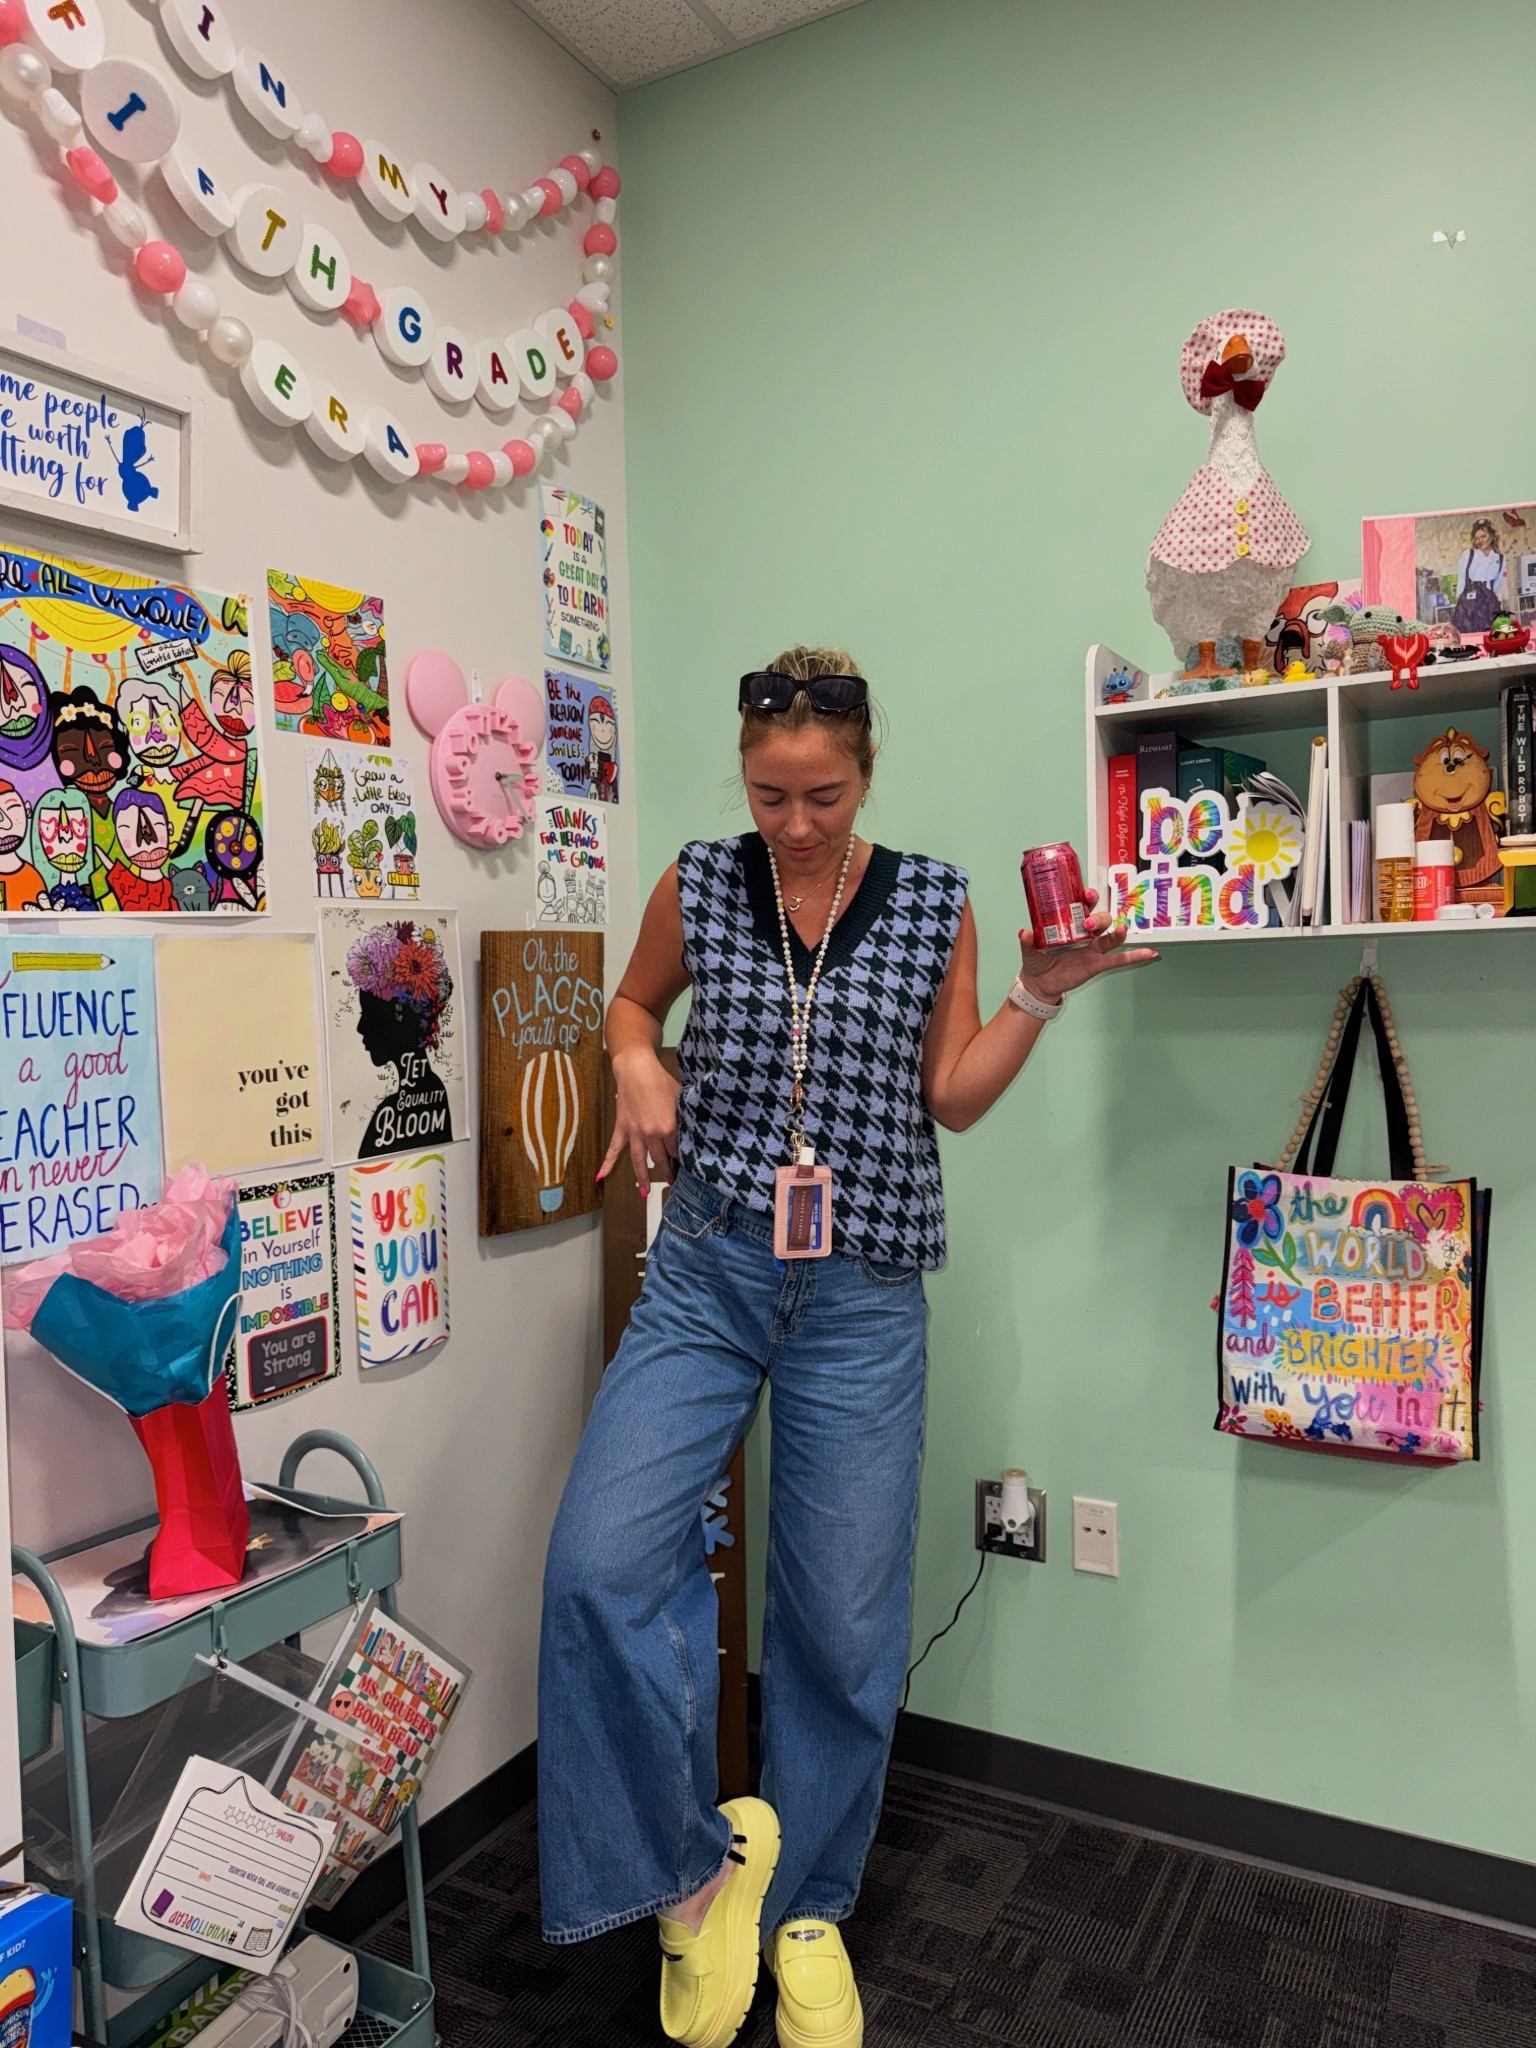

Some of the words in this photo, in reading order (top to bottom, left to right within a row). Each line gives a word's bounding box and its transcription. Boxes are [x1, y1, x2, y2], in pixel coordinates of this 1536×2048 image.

[378, 153, 450, 217] MY
[398, 305, 576, 385] GRADE
[45, 391, 120, 438] people
[273, 363, 409, 460] ERA
[28, 423, 91, 459] worth
[76, 461, 108, 504] for
[563, 523, 594, 555] TODAY
[559, 560, 585, 586] GREAT
[586, 571, 600, 591] DAY
[573, 551, 580, 562] IS
[581, 554, 587, 565] A
[38, 563, 86, 597] ALL
[557, 584, 569, 606] TO
[571, 586, 605, 620] LEARN
[560, 611, 601, 633] SOMETHING
[547, 679, 562, 701] BE
[549, 703, 586, 724] REASON
[1517, 705, 1526, 732] THE
[549, 725, 583, 742] SOMEONE
[557, 762, 590, 784] TODAY
[1515, 737, 1527, 773] WILD
[371, 803, 391, 814] DAY
[1517, 776, 1526, 823] ROBOT
[545, 805, 598, 836] THANKS
[1146, 797, 1223, 856] be
[540, 831, 558, 845] FOR
[560, 831, 599, 850] HELPING
[548, 849, 567, 863] ME
[1113, 861, 1260, 930] kind
[553, 937, 579, 973] the
[492, 973, 604, 1038] PLACES
[559, 1023, 581, 1053] go
[18, 1057, 41, 1084] a
[64, 1030, 129, 1110] good
[237, 1059, 310, 1093] you've
[400, 1052, 429, 1088] LET
[276, 1090, 312, 1118] got
[397, 1089, 446, 1112] EQUALITY
[270, 1123, 313, 1148] this
[375, 1105, 447, 1148] BLOOM
[29, 1140, 130, 1192] never
[1287, 1180, 1350, 1225] the
[240, 1203, 324, 1242] BELIEVE
[243, 1247, 257, 1265] in
[261, 1227, 322, 1259] Yourself
[374, 1228, 439, 1286] YOU
[1304, 1228, 1429, 1281] WORLD
[242, 1252, 323, 1291] NOTHING
[1257, 1270, 1301, 1309] is
[281, 1283, 292, 1300] is
[381, 1278, 440, 1337] CAN
[240, 1292, 330, 1334] IMPOSSIBLE
[262, 1339, 288, 1359] You
[291, 1328, 316, 1349] are
[1226, 1322, 1276, 1358] and
[262, 1348, 312, 1377] Strong
[1231, 1371, 1286, 1406] with
[1303, 1382, 1386, 1424] you
[1396, 1385, 1422, 1426] in
[352, 1700, 388, 1738] BOOK
[357, 1672, 379, 1700] MS.
[382, 1691, 438, 1741] GRUBER'S
[168, 1910, 238, 1945] #WHATTOREAD
[6, 1939, 26, 1958] KID?
